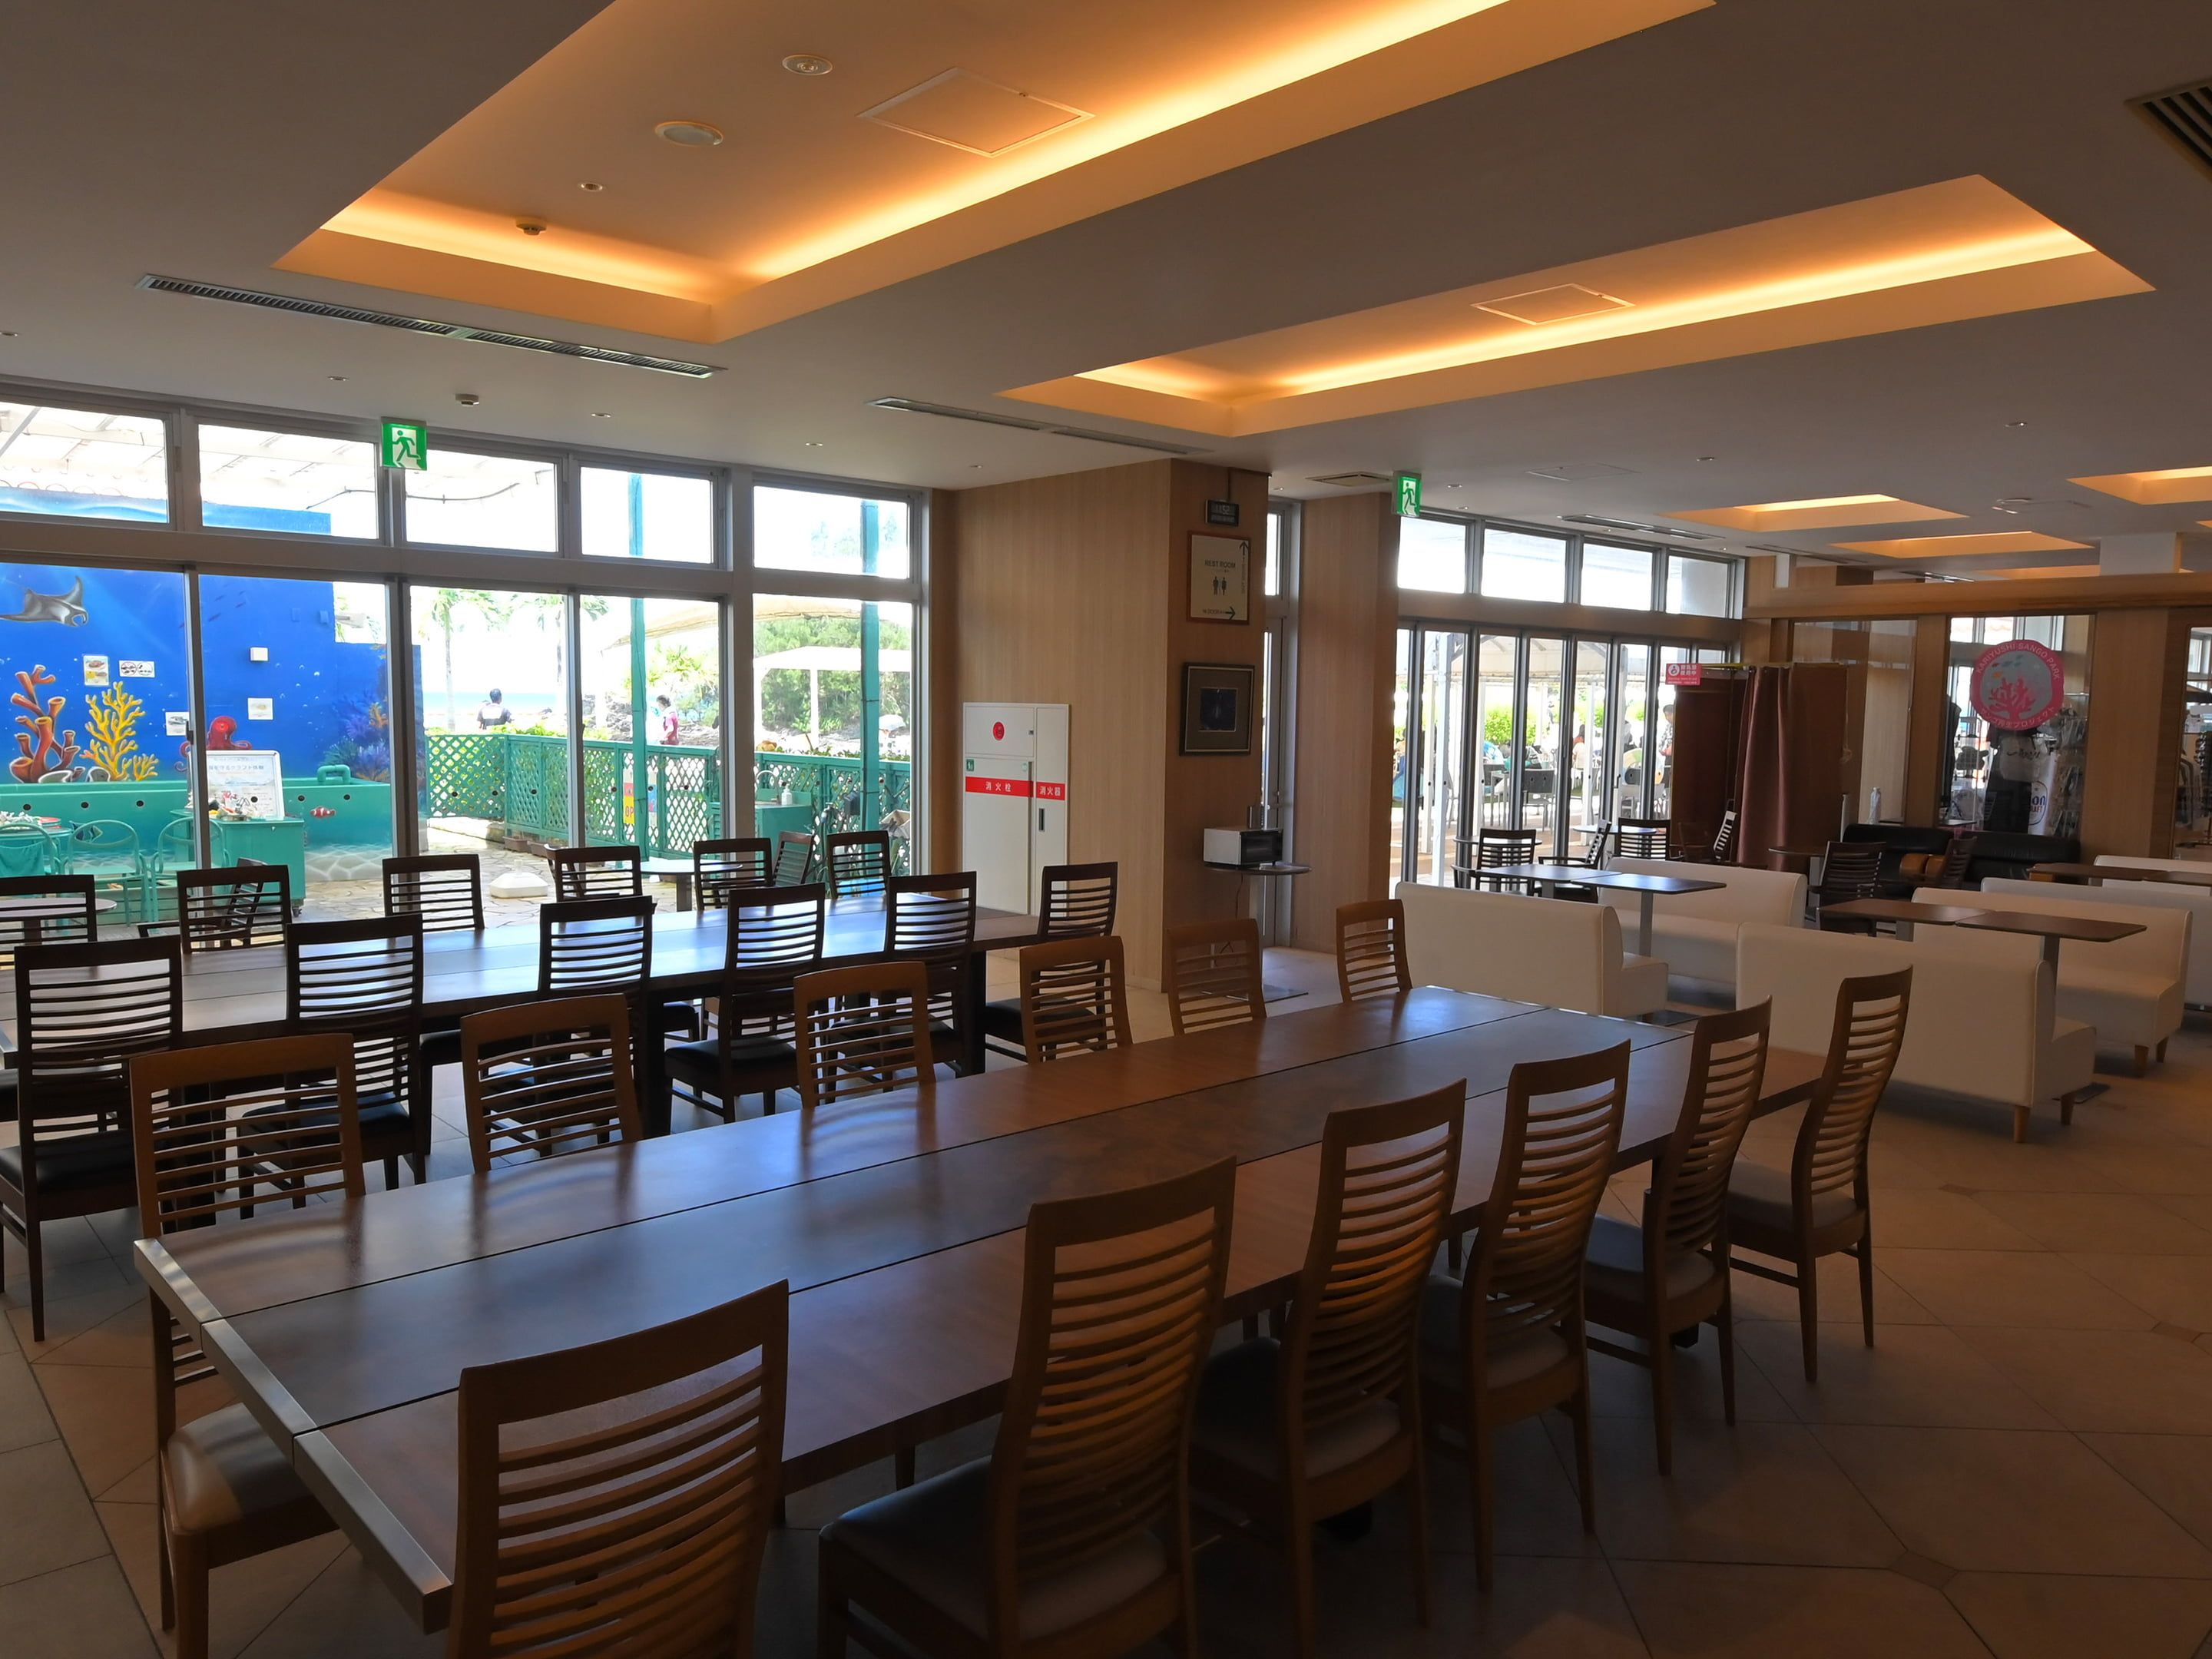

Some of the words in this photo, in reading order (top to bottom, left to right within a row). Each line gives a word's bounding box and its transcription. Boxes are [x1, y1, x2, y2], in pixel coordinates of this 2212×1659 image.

[1976, 644, 2016, 674] KARIYUSHI
[2018, 643, 2048, 658] SANGO
[2046, 657, 2061, 680] PARK
[985, 781, 1012, 792] 消火栓
[1039, 786, 1061, 796] 消火器
[625, 806, 634, 817] OP
